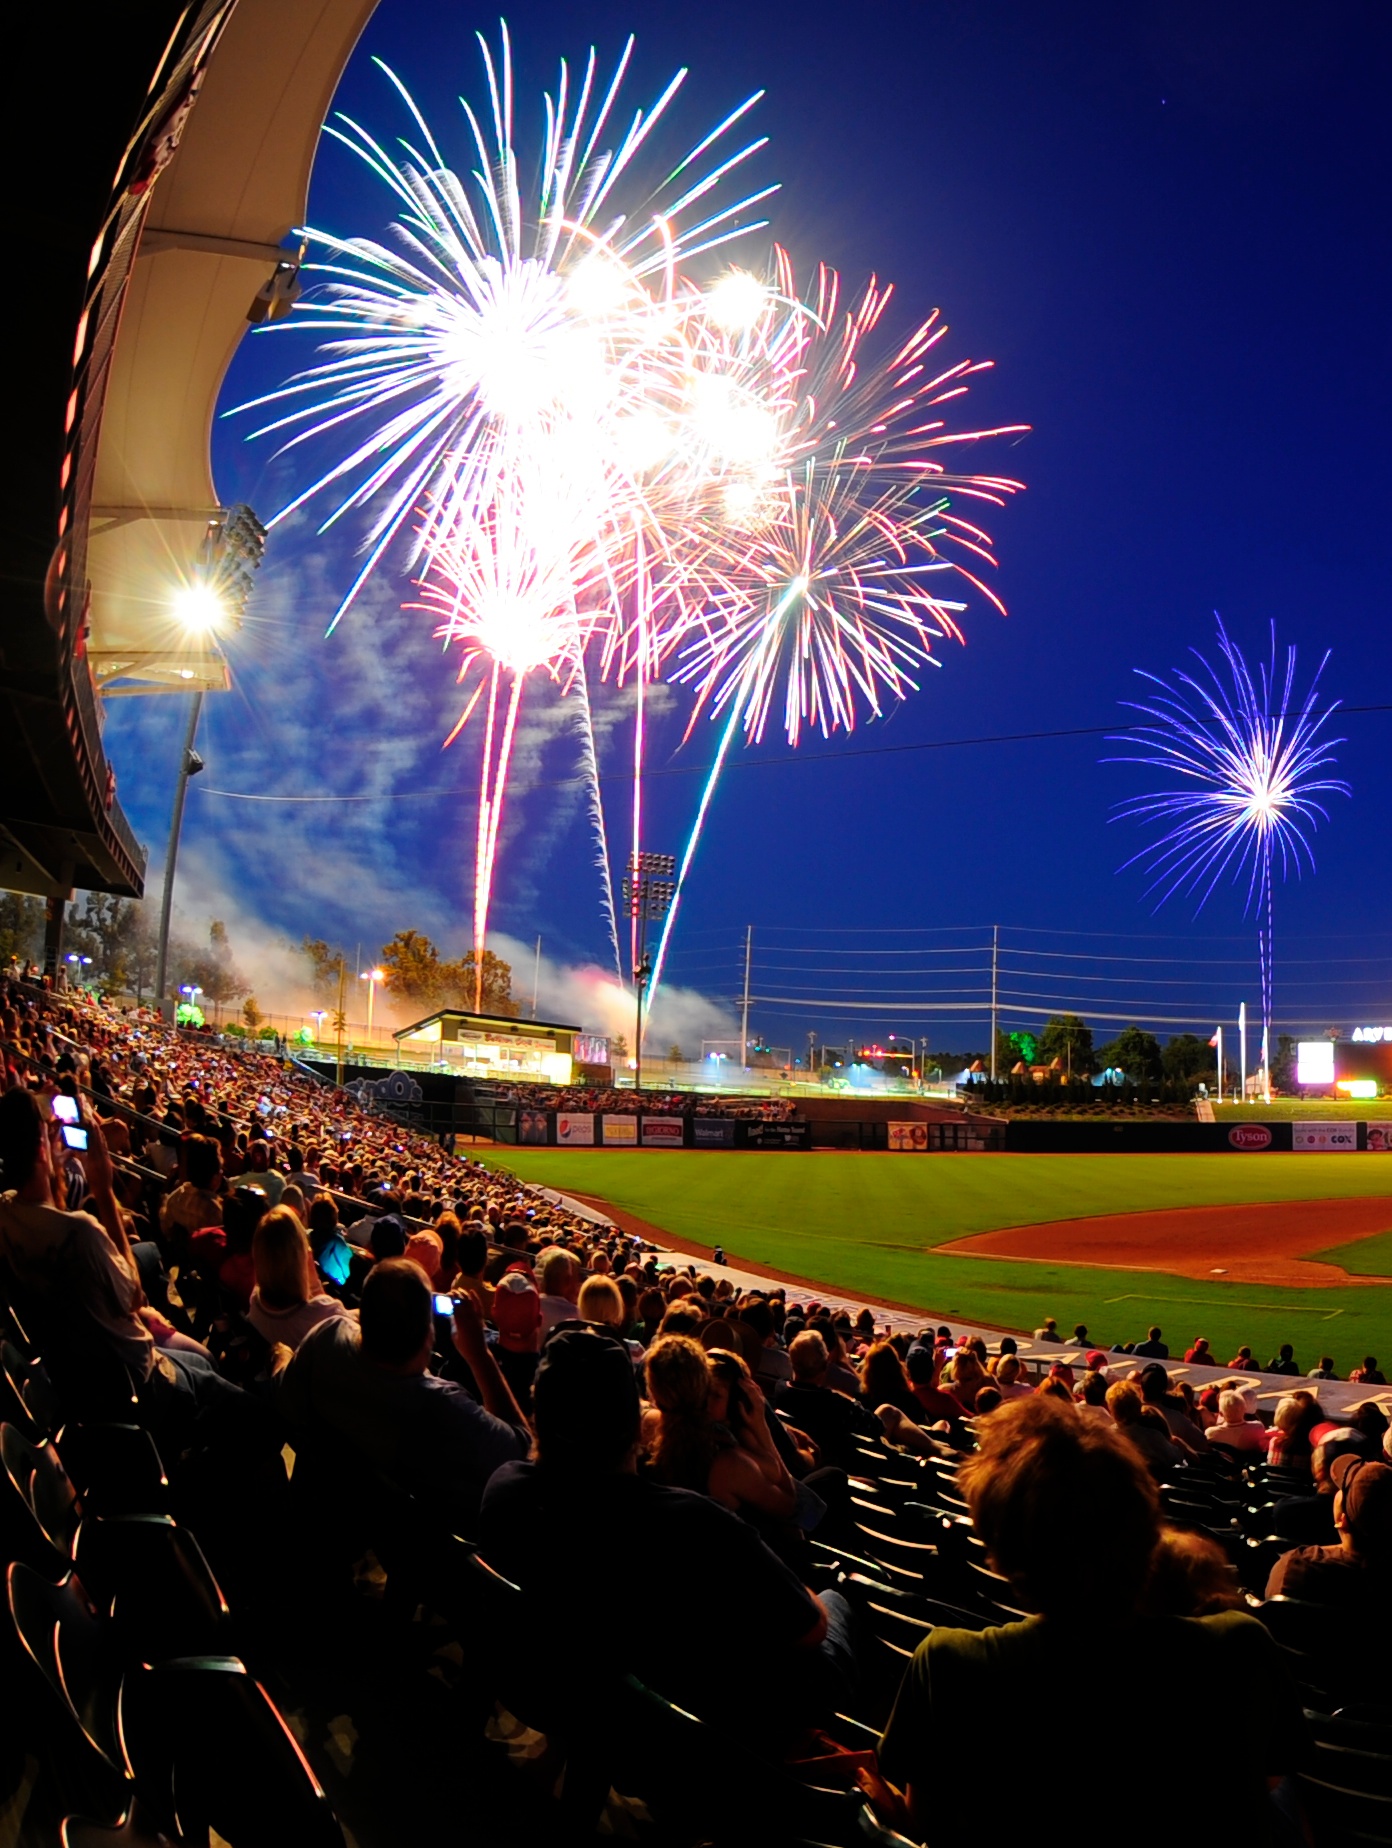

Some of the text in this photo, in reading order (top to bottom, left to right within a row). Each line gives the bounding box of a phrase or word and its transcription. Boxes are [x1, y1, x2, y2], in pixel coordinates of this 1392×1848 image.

[695, 1129, 723, 1138] Walmart
[1235, 1130, 1267, 1144] Tyson
[1331, 1135, 1352, 1143] COX
